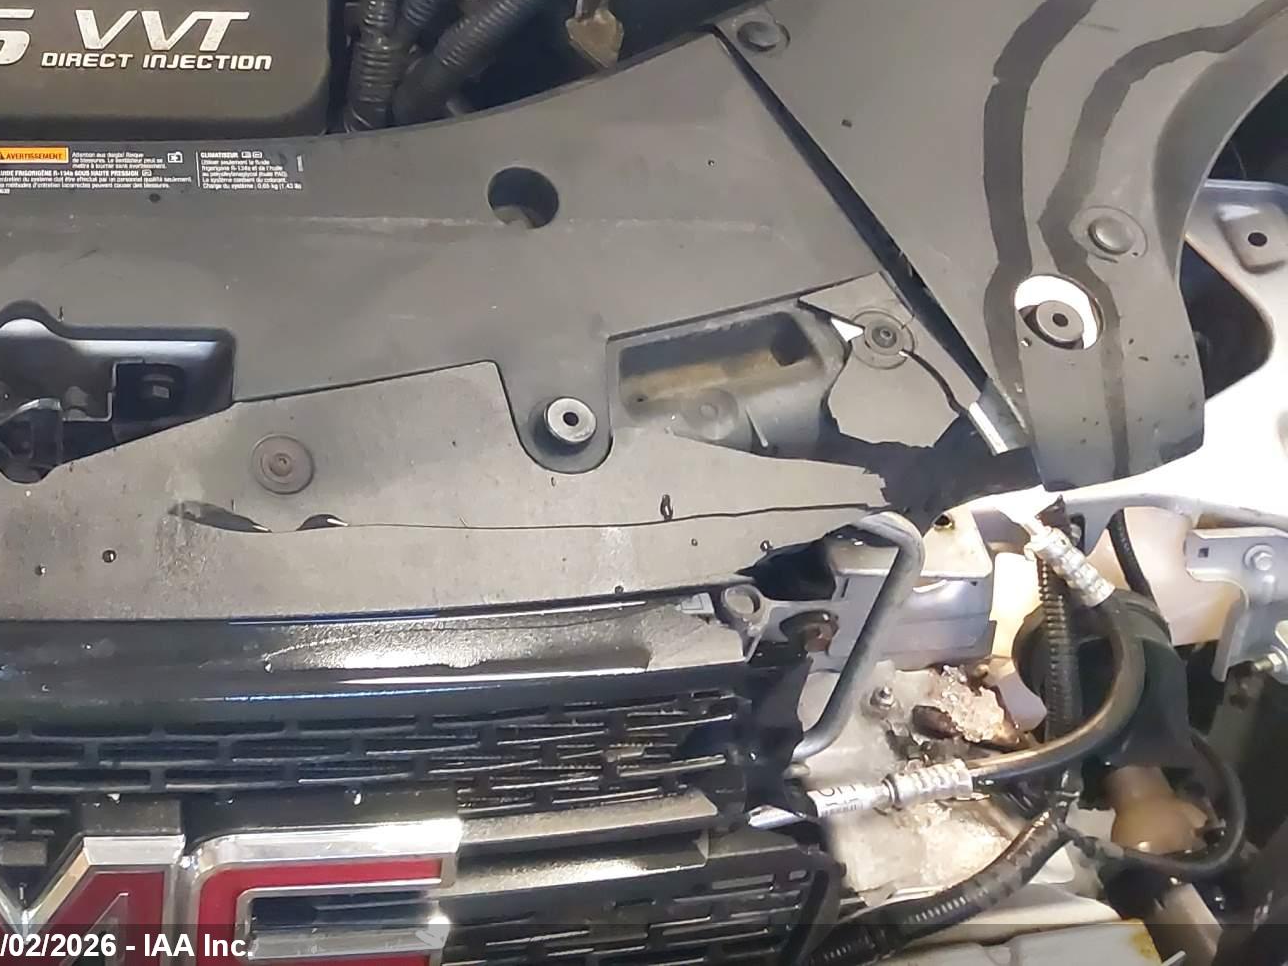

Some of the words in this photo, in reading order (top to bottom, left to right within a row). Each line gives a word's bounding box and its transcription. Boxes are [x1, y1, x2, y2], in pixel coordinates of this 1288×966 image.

[75, 9, 250, 52] VVT
[41, 52, 134, 69] DIRECT
[143, 53, 272, 71] INJECTION
